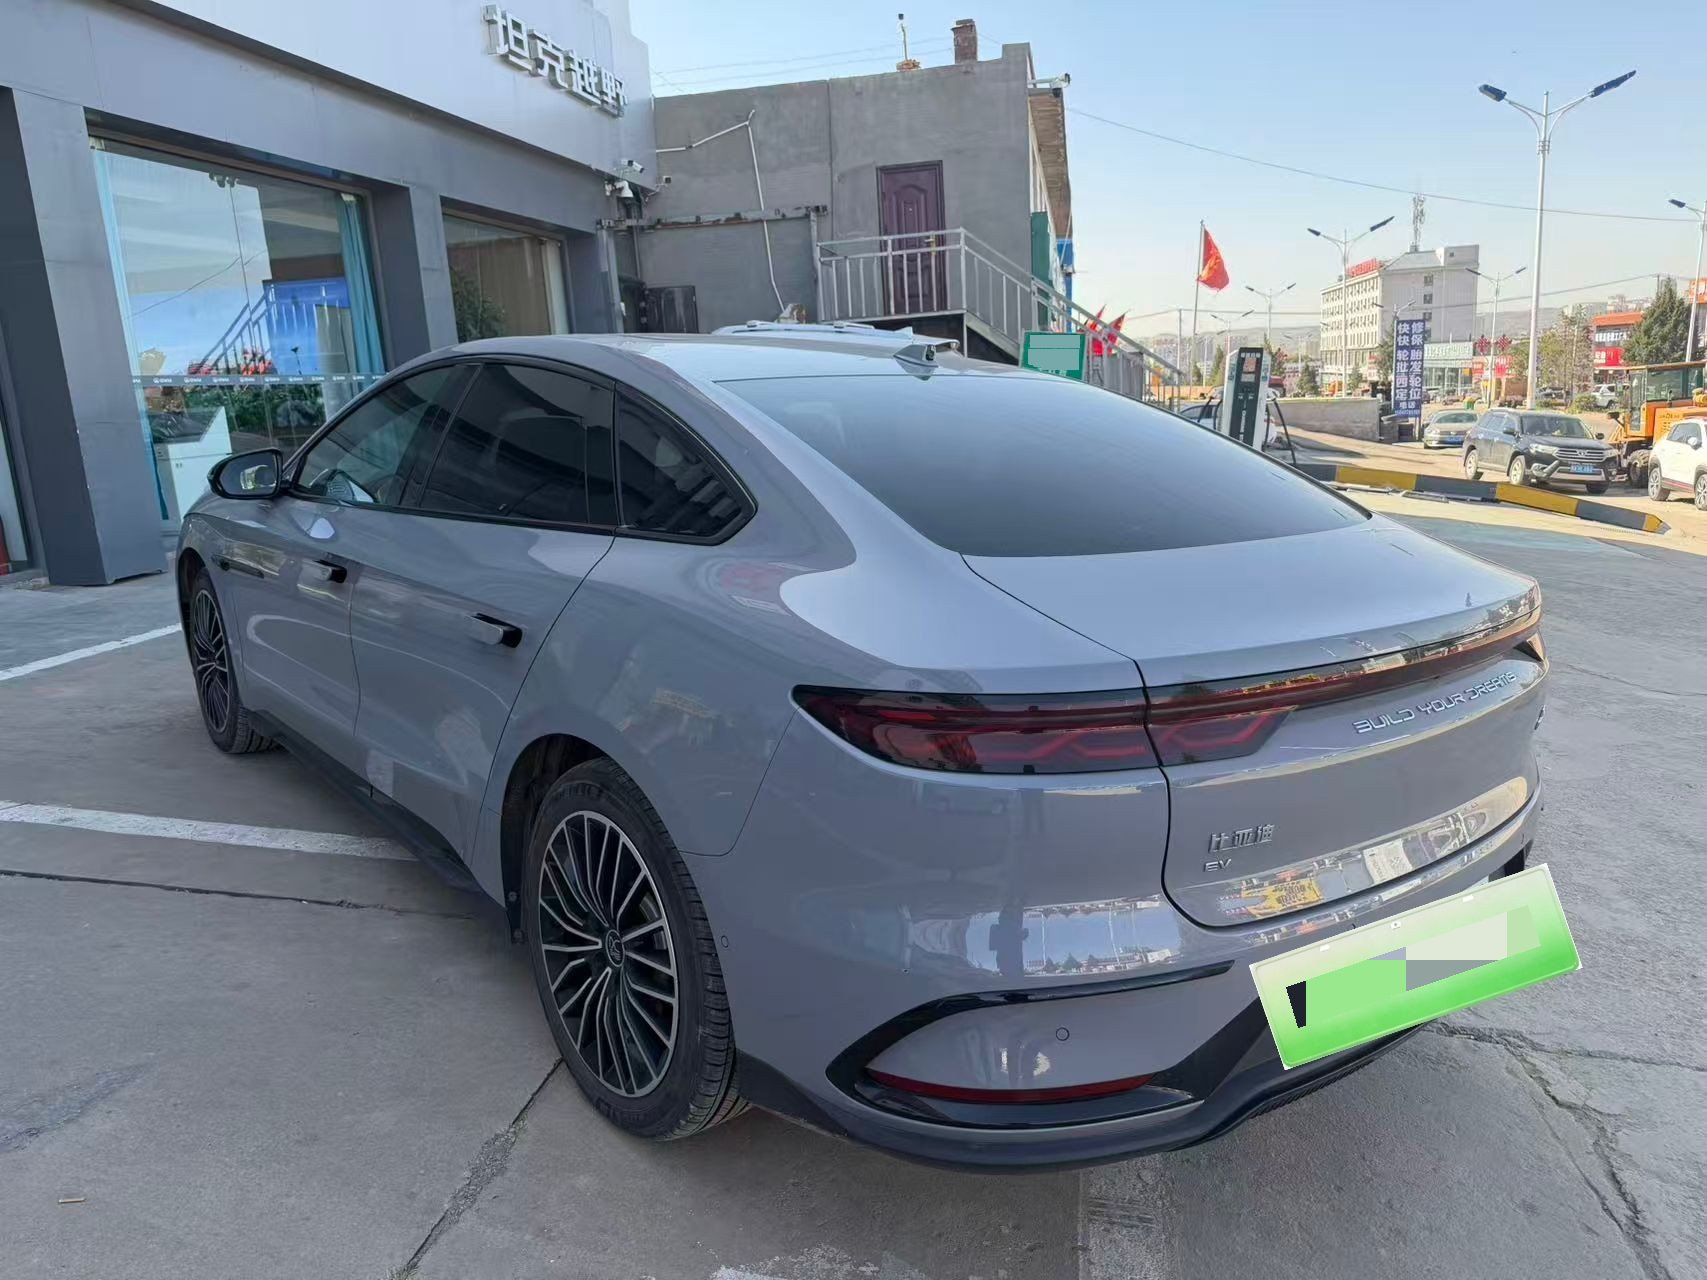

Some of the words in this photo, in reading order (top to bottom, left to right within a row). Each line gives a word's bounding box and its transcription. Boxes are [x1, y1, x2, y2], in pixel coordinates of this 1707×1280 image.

[1353, 708, 1416, 734] BUILD
[1416, 692, 1467, 716] YOUR
[1464, 671, 1518, 701] DREAMS
[1208, 824, 1275, 853] 比亚迪
[1203, 858, 1232, 872] EV
